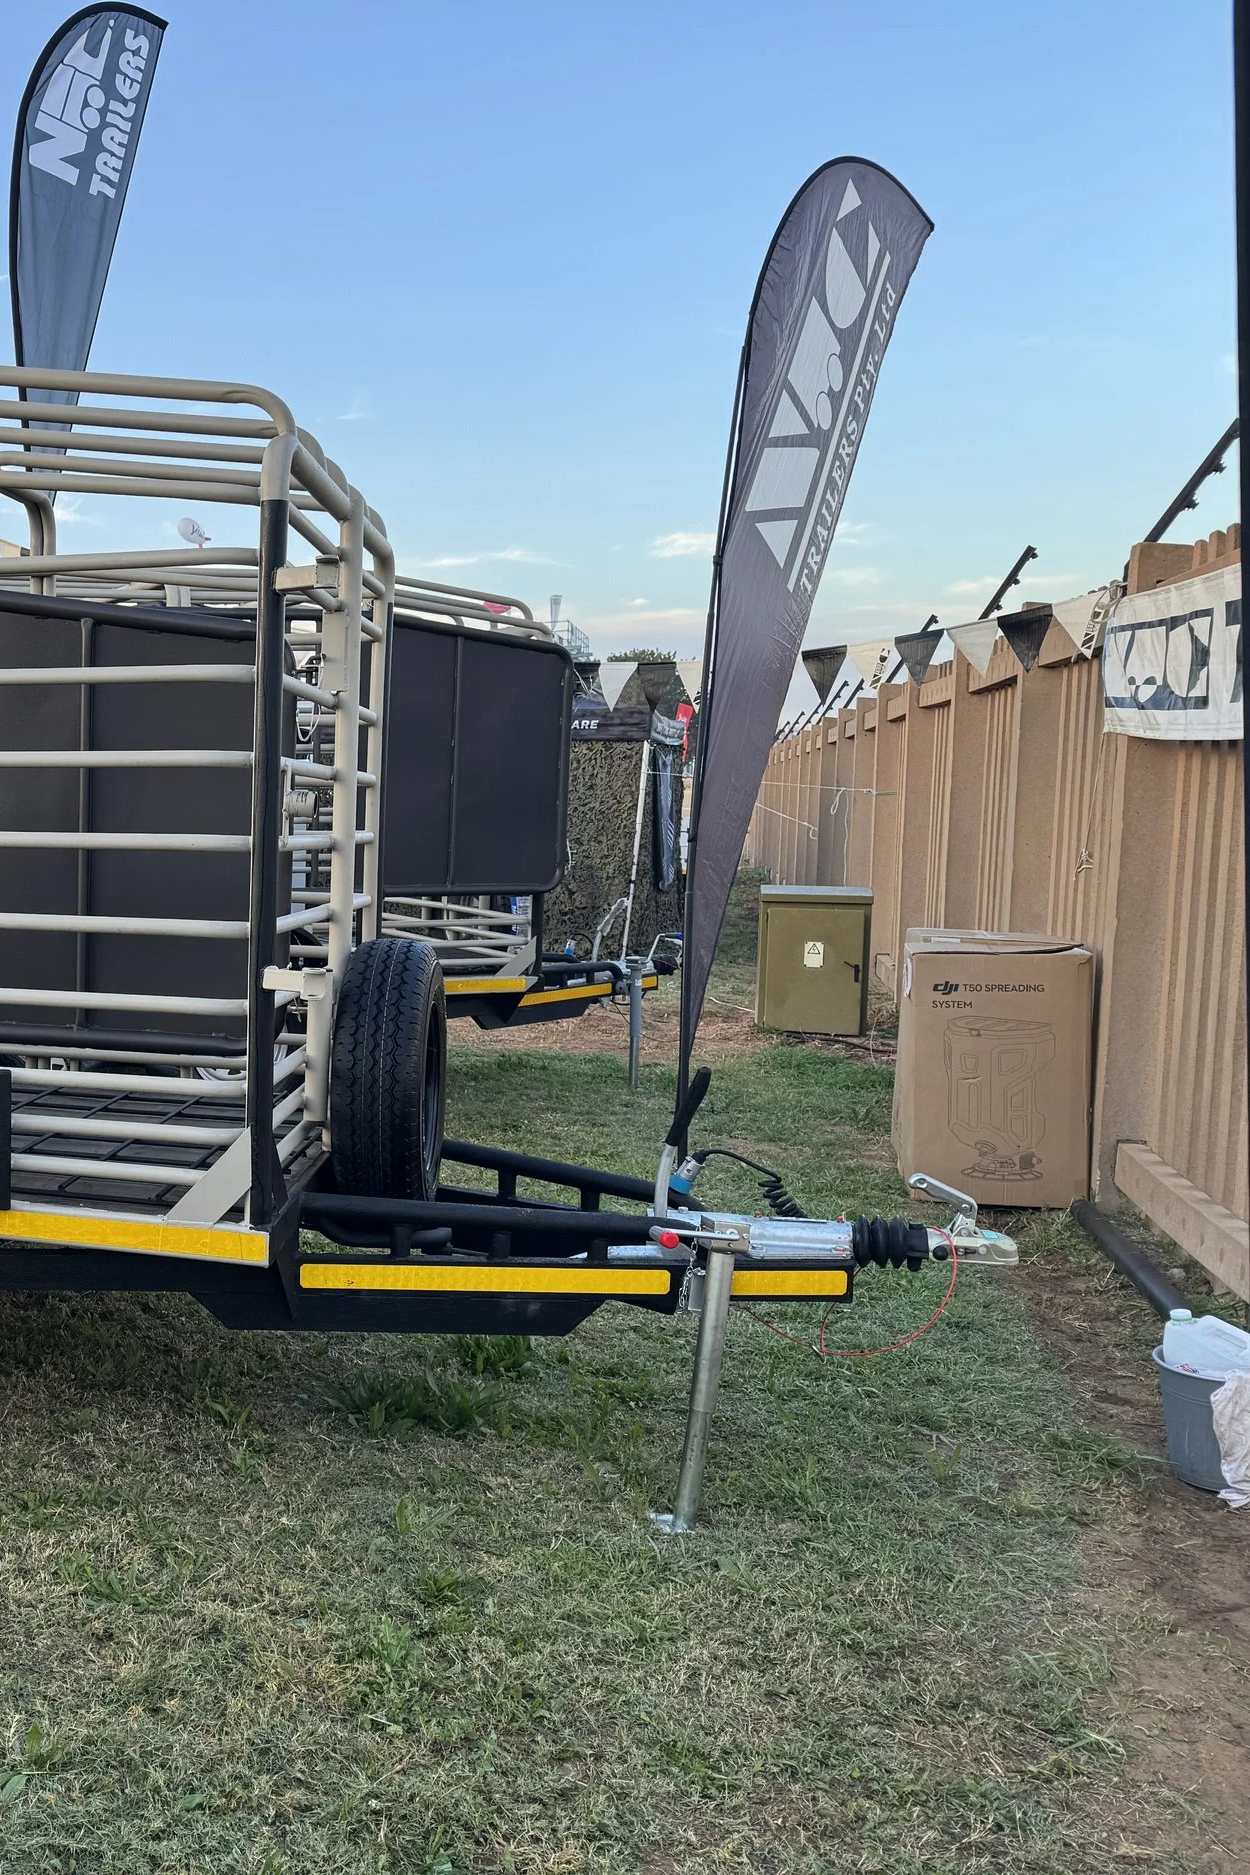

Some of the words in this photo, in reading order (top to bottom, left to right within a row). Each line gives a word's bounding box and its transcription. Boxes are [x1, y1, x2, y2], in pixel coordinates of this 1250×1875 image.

[89, 28, 149, 199] TRAILERS
[800, 414, 859, 597] TRAILERS
[854, 353, 880, 407] Pty.
[874, 280, 897, 344] Ltd
[932, 1000, 973, 1009] SYSTEM
[962, 984, 983, 993] T50
[985, 983, 1045, 993] SPREADING
